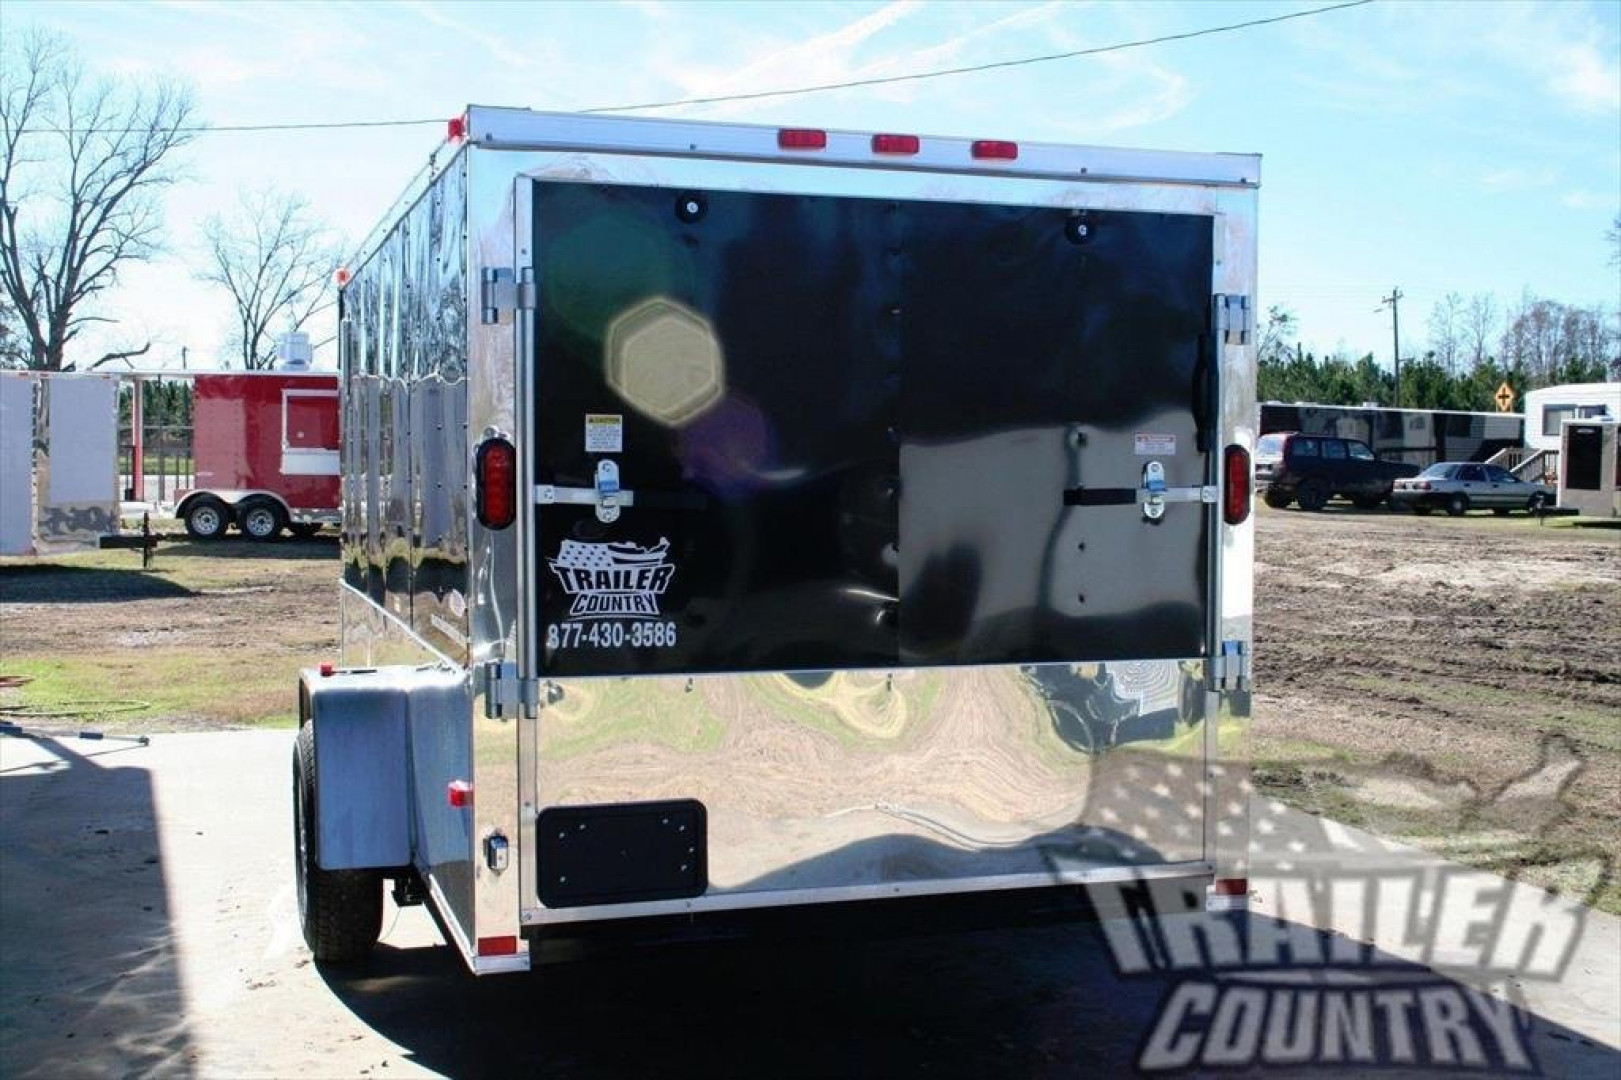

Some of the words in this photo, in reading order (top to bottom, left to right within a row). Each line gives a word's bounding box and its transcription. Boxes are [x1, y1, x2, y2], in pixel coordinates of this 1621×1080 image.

[552, 564, 675, 594] TRAILER
[570, 593, 658, 614] COUNTRY
[547, 621, 677, 649] 877-430-3586
